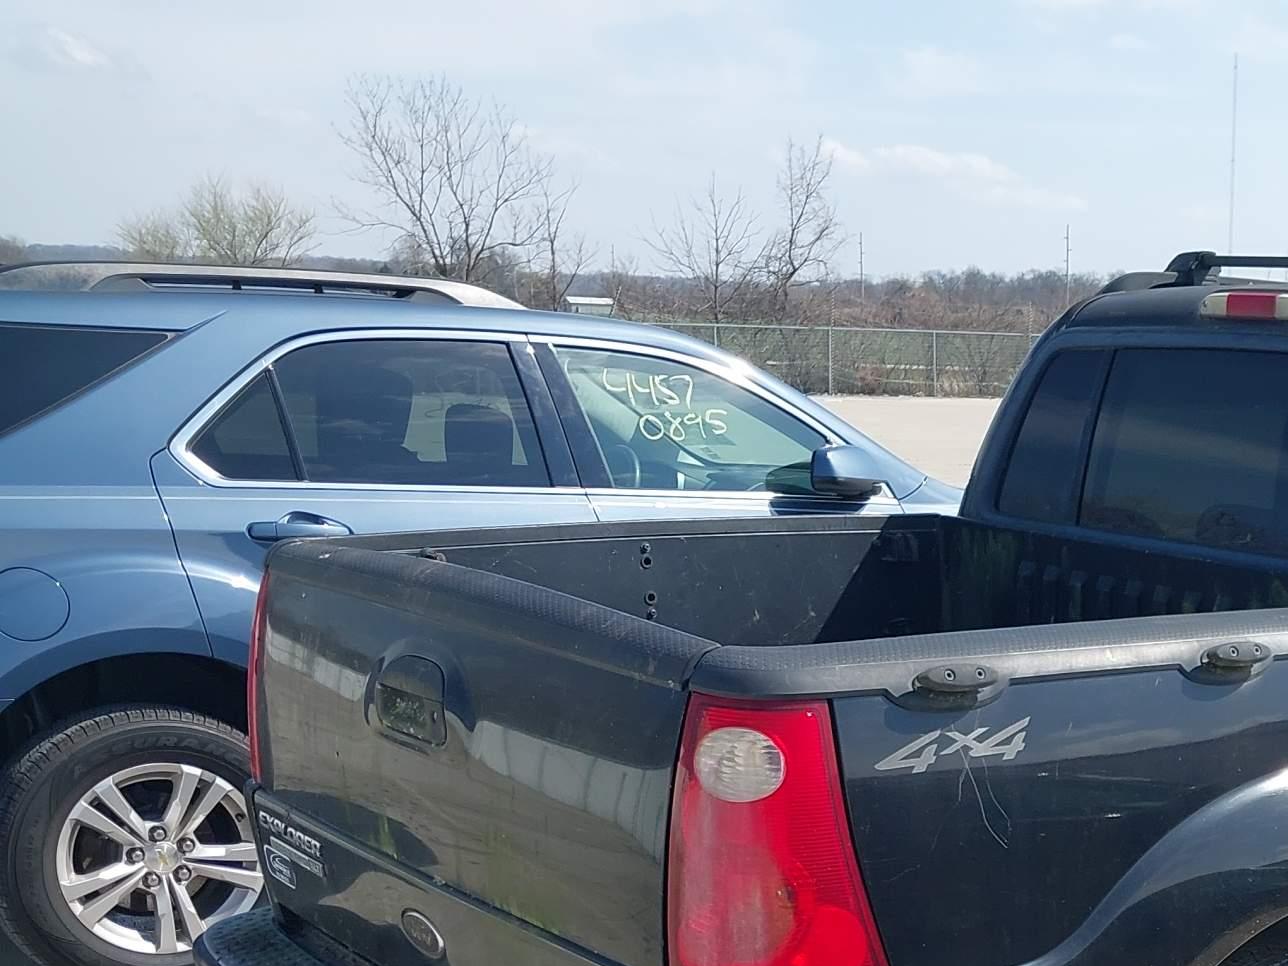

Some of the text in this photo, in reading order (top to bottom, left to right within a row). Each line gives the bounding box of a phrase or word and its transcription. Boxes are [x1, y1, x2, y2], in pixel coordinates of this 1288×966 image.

[602, 368, 693, 409] 4457
[639, 409, 727, 441] 0895
[258, 811, 322, 857] EXPLORER
